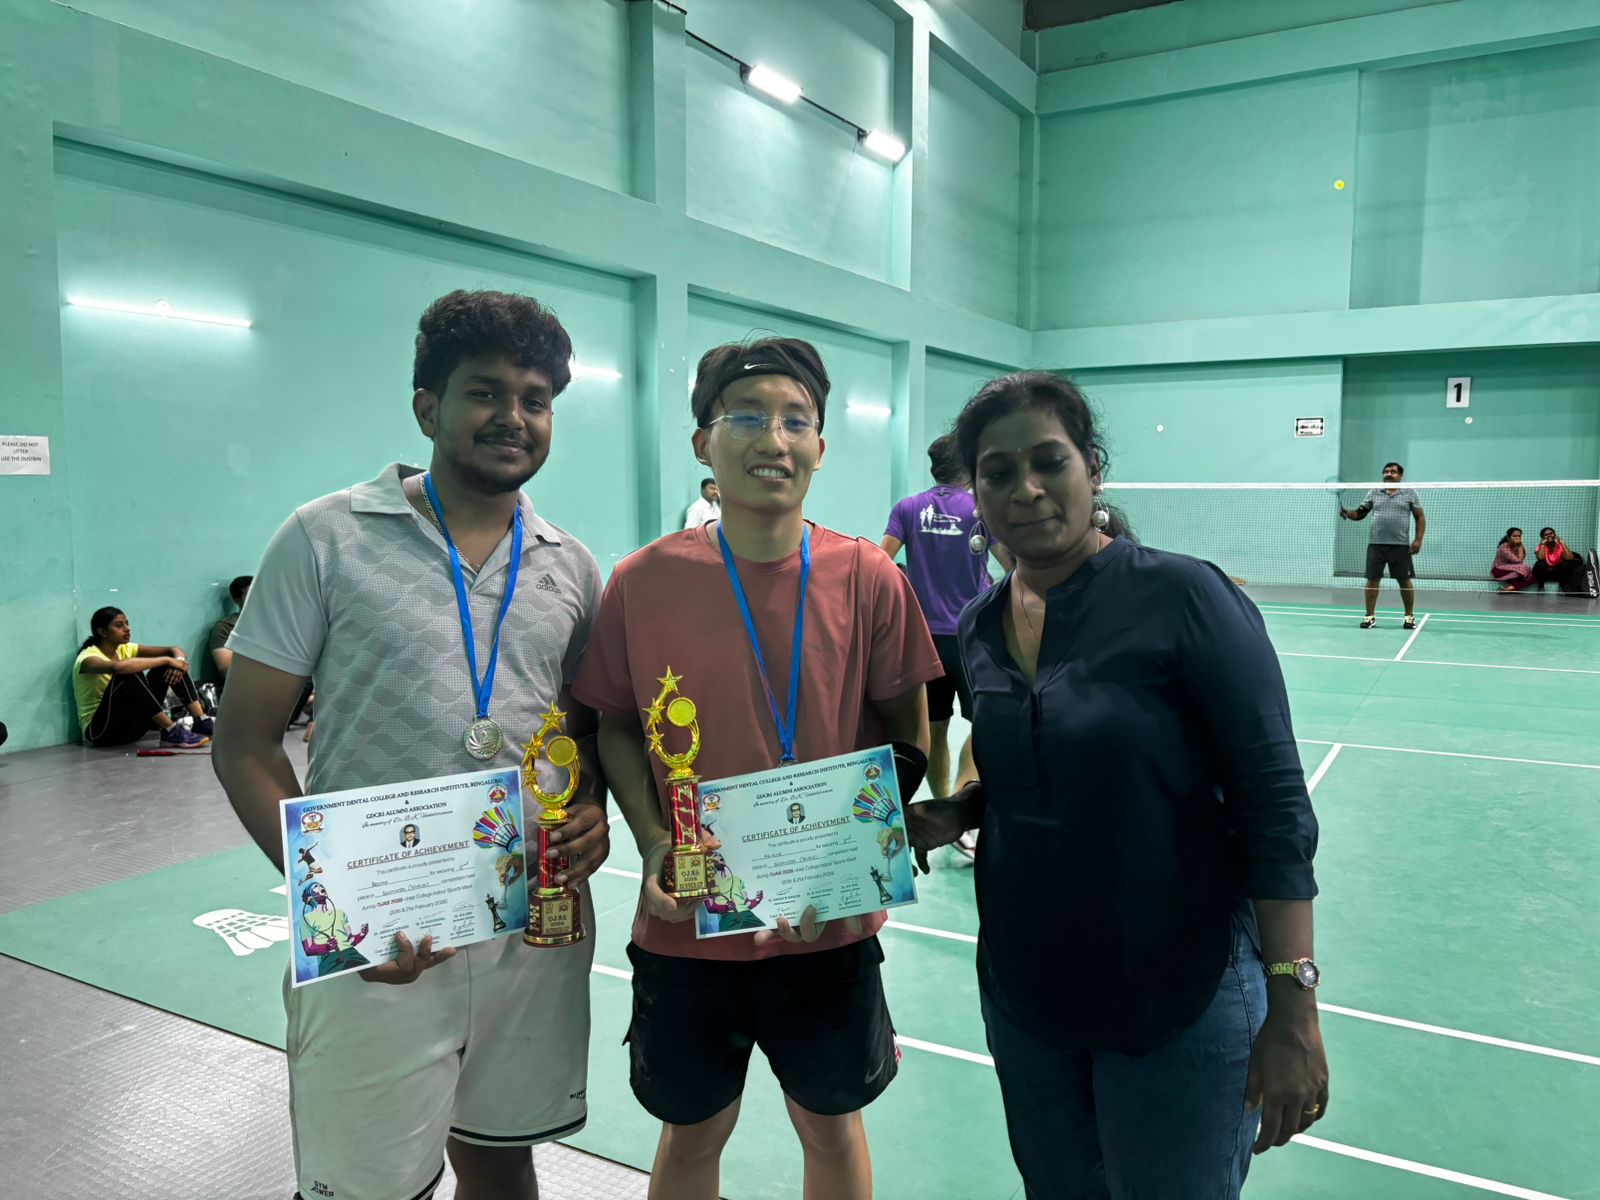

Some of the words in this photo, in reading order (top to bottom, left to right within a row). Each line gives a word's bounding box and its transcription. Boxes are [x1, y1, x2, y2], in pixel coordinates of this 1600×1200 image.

[1454, 383, 1462, 402] 1
[536, 584, 562, 594] adidas
[704, 785, 738, 796] GOVERNMENT
[739, 781, 758, 789] DENTAL
[759, 777, 781, 785] COLLEGE
[794, 769, 819, 778] RESEARCH
[847, 758, 877, 767] BENGALURU
[794, 782, 827, 792] ASSOCIATION
[303, 802, 346, 813] GOVERNMENT
[347, 798, 368, 806] DENTAL
[369, 795, 394, 803] COLLEGE
[411, 788, 439, 797] RESEARCH
[471, 779, 503, 787] BENGALURU
[385, 808, 408, 816] ALUMNI
[409, 802, 447, 812] ASSOCIATION
[742, 829, 787, 842] CERTIFICATE
[801, 817, 850, 831] ACHIEVEMENT
[347, 853, 401, 869] CERTIFICATE
[403, 851, 413, 859] OF
[415, 841, 469, 856] ACHIEVEMENT
